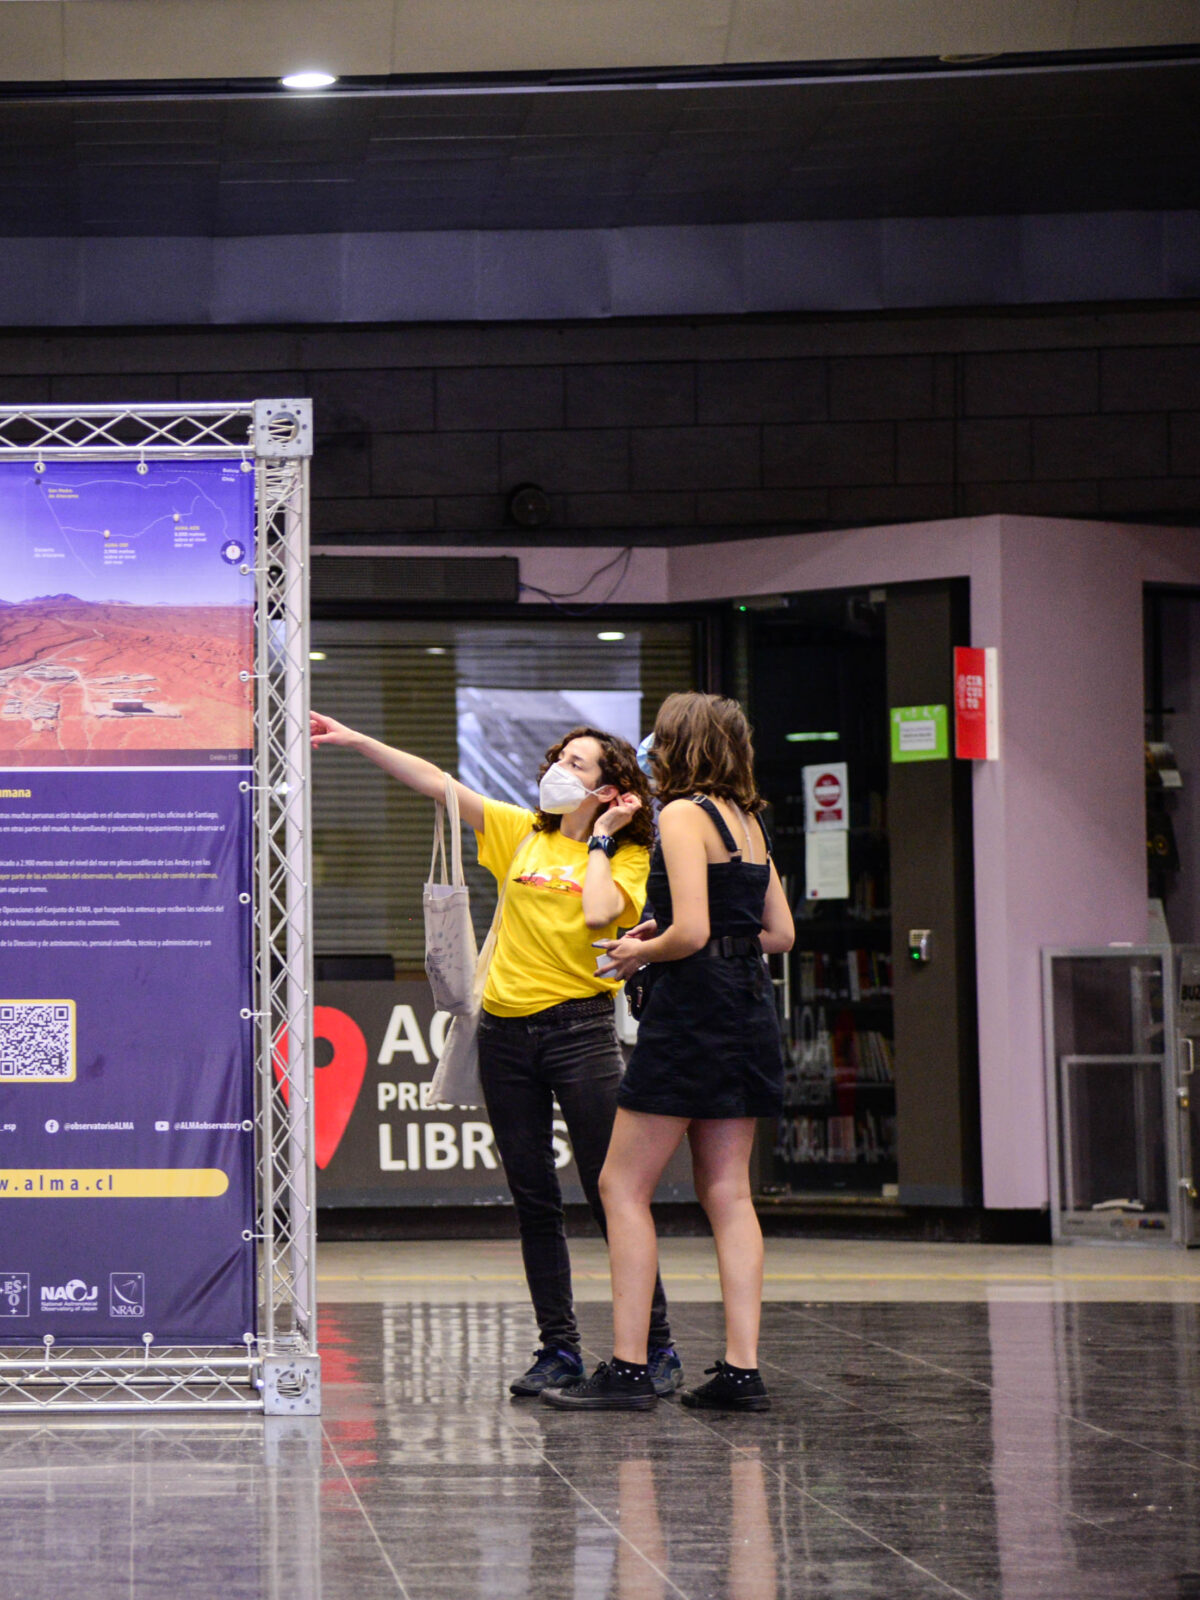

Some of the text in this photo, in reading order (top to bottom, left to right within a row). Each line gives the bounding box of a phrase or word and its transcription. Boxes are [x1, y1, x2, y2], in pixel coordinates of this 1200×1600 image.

[64, 1121, 134, 1131] @observatorioALMA
[174, 1121, 241, 1131] @ALMAobservatory
[379, 1122, 572, 1171] LIBRS
[41, 1279, 98, 1302] NAOJ
[111, 1305, 144, 1316] NRAO
